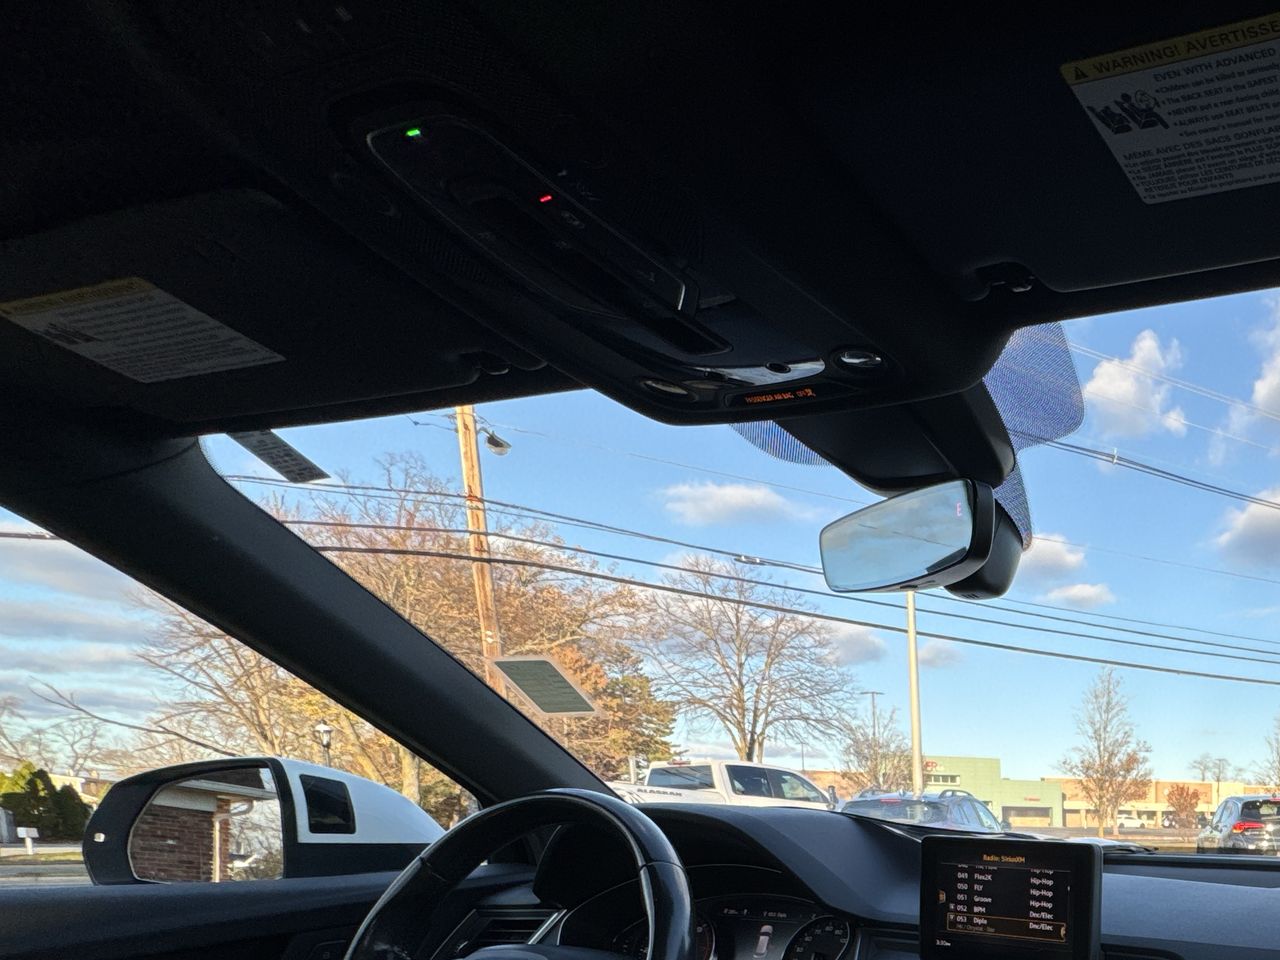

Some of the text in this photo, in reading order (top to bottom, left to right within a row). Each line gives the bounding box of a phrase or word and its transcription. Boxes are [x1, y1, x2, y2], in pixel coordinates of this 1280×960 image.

[1092, 44, 1182, 74] WARNING!
[1153, 69, 1181, 82] EVEN
[1183, 62, 1213, 75] WITH
[1215, 47, 1276, 68] ADVANCED
[957, 872, 968, 880] 049
[956, 893, 968, 901] 051
[956, 905, 968, 913] 052
[973, 906, 986, 914] BPM
